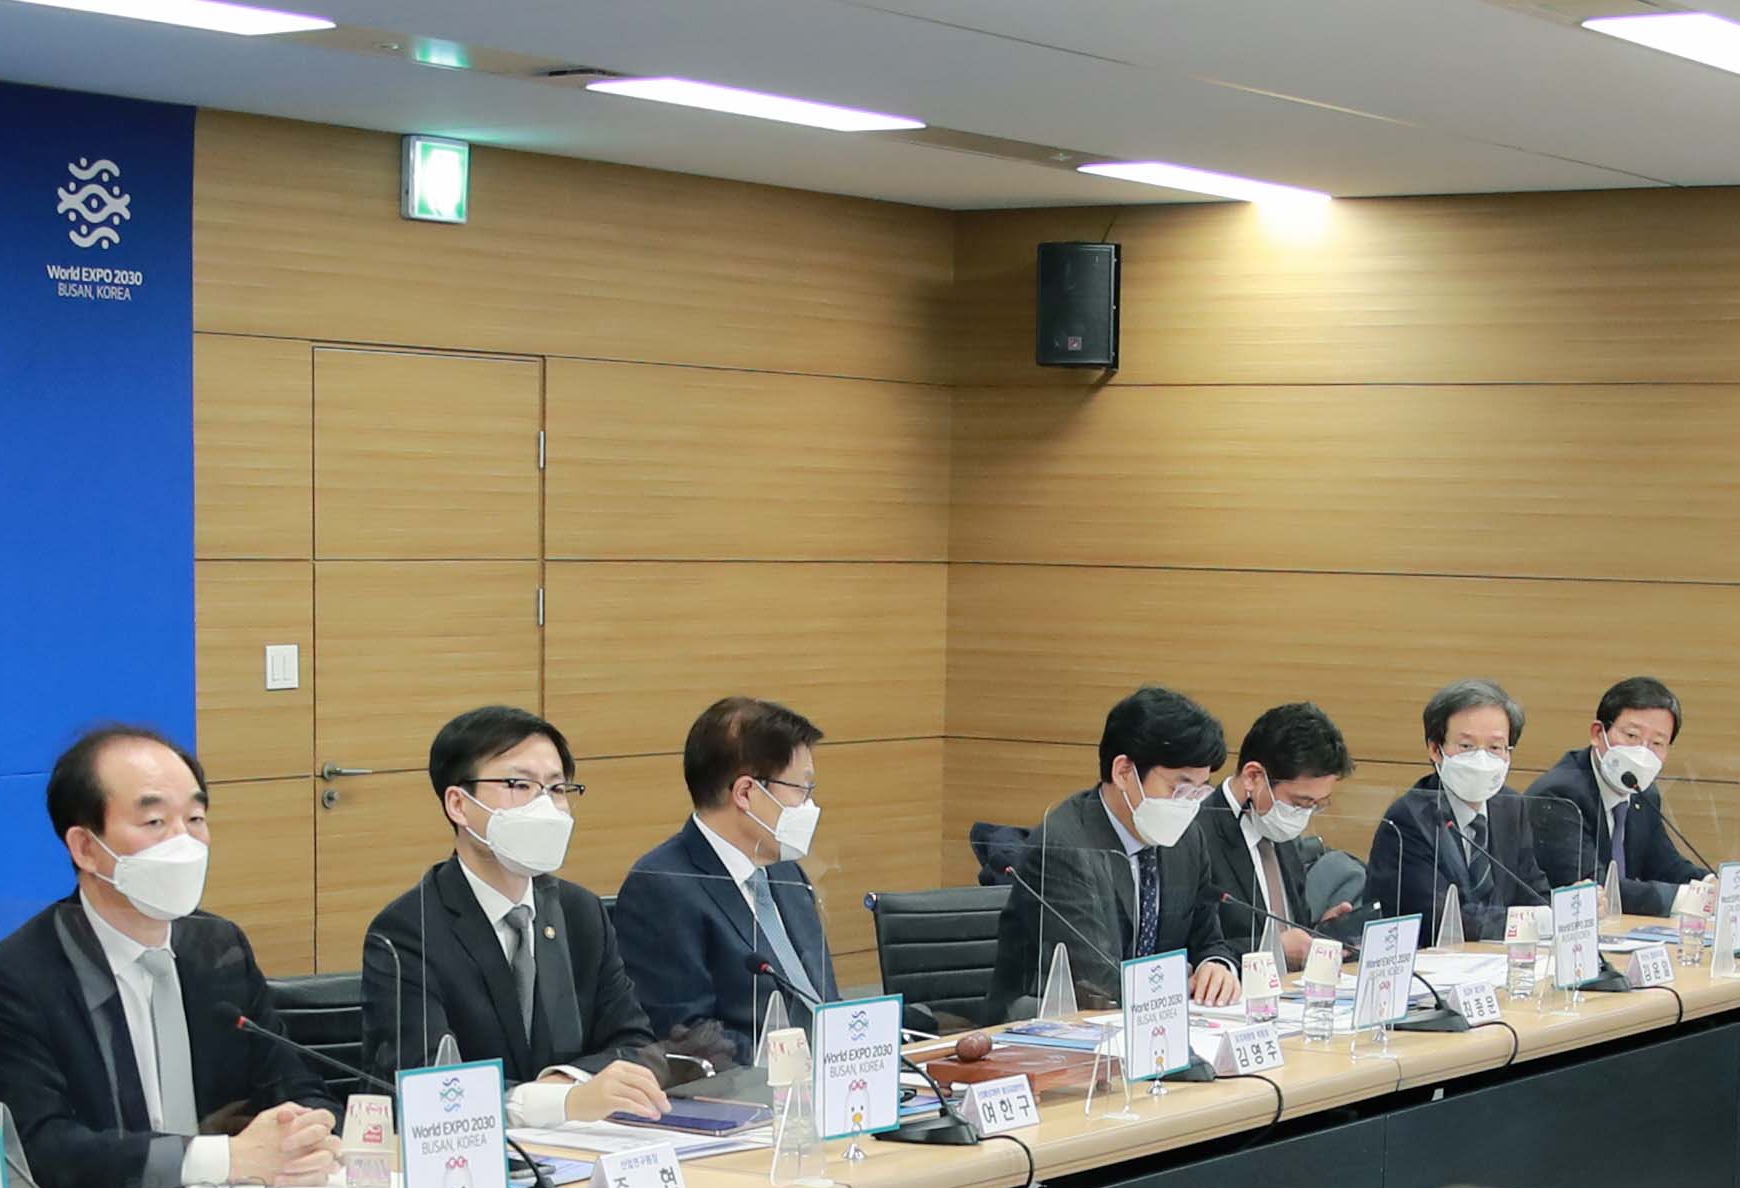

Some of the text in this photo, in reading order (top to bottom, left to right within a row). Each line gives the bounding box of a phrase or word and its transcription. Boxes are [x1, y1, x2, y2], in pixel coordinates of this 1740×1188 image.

[46, 264, 143, 286] World EXPO 2030
[58, 283, 132, 301] BUSAN, KOREA
[823, 1043, 893, 1065] World EXPO 2030
[860, 1059, 885, 1074] KOREA
[981, 1094, 1031, 1124] 여한구
[412, 1115, 496, 1139] World EXPO 2030
[457, 1134, 487, 1149] KOREA
